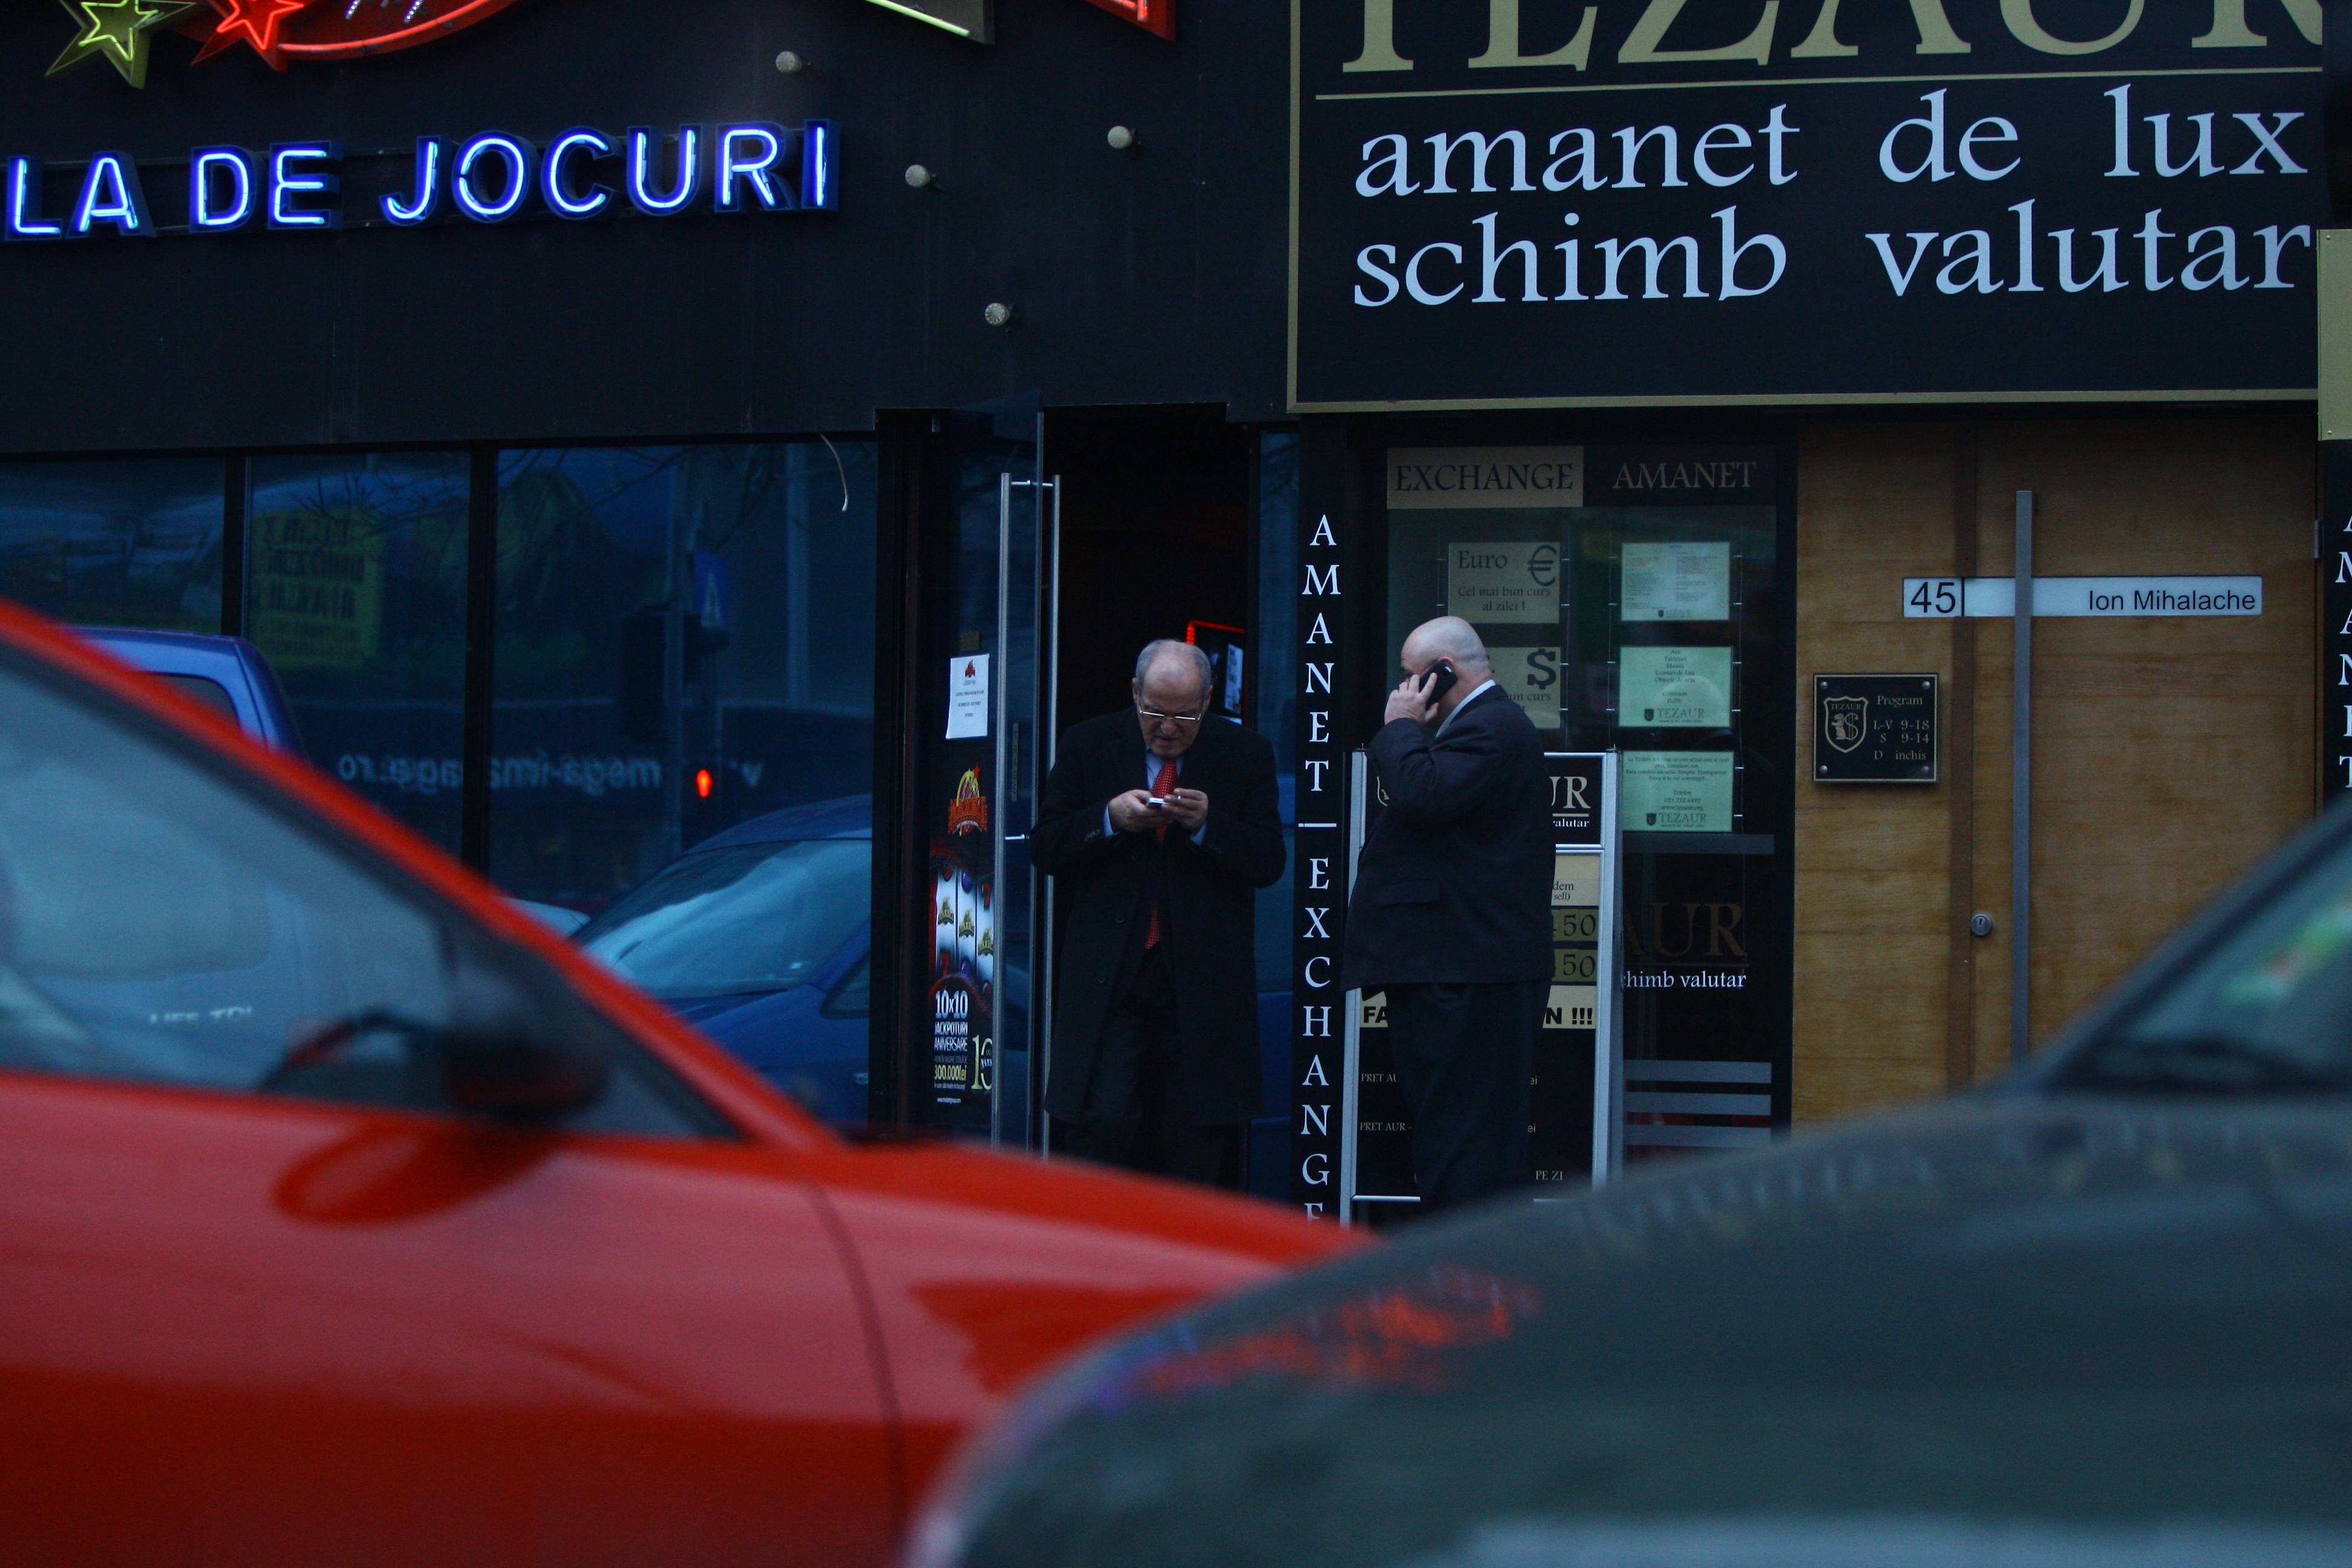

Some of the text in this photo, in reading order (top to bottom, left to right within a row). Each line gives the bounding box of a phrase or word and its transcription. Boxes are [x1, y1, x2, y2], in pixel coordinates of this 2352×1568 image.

[1355, 83, 2308, 197] amanet de lux
[191, 142, 342, 232] DE
[379, 119, 840, 226] JOCURI
[1354, 198, 2311, 307] schimb valutar
[1394, 462, 1757, 492] EXCHANGE AMANET
[1457, 550, 1508, 569] Euro
[1458, 586, 1475, 596] Cel
[1479, 586, 1499, 596] mai
[1502, 586, 1523, 596] bun
[1910, 581, 2256, 614] 45 Ion Mihalache
[1483, 601, 1492, 612] al
[1302, 514, 1342, 792] AMANET
[1877, 695, 1923, 708] Program
[1656, 708, 1705, 719] TEZAUR
[1873, 719, 1930, 731] L-V 9-18
[1880, 733, 1930, 743] S 9-14
[1874, 750, 1927, 760] D inchis
[1658, 812, 1707, 823] TEZAUR
[1624, 969, 1748, 989] himb valutar
[935, 989, 969, 1019] 10x10
[935, 1021, 969, 1036] JACKPOTURI
[934, 1036, 968, 1051] ANIVERSARE
[1361, 1073, 1384, 1082] PRET
[1359, 1122, 1382, 1131] PRET
[1385, 1122, 1406, 1131] AUR
